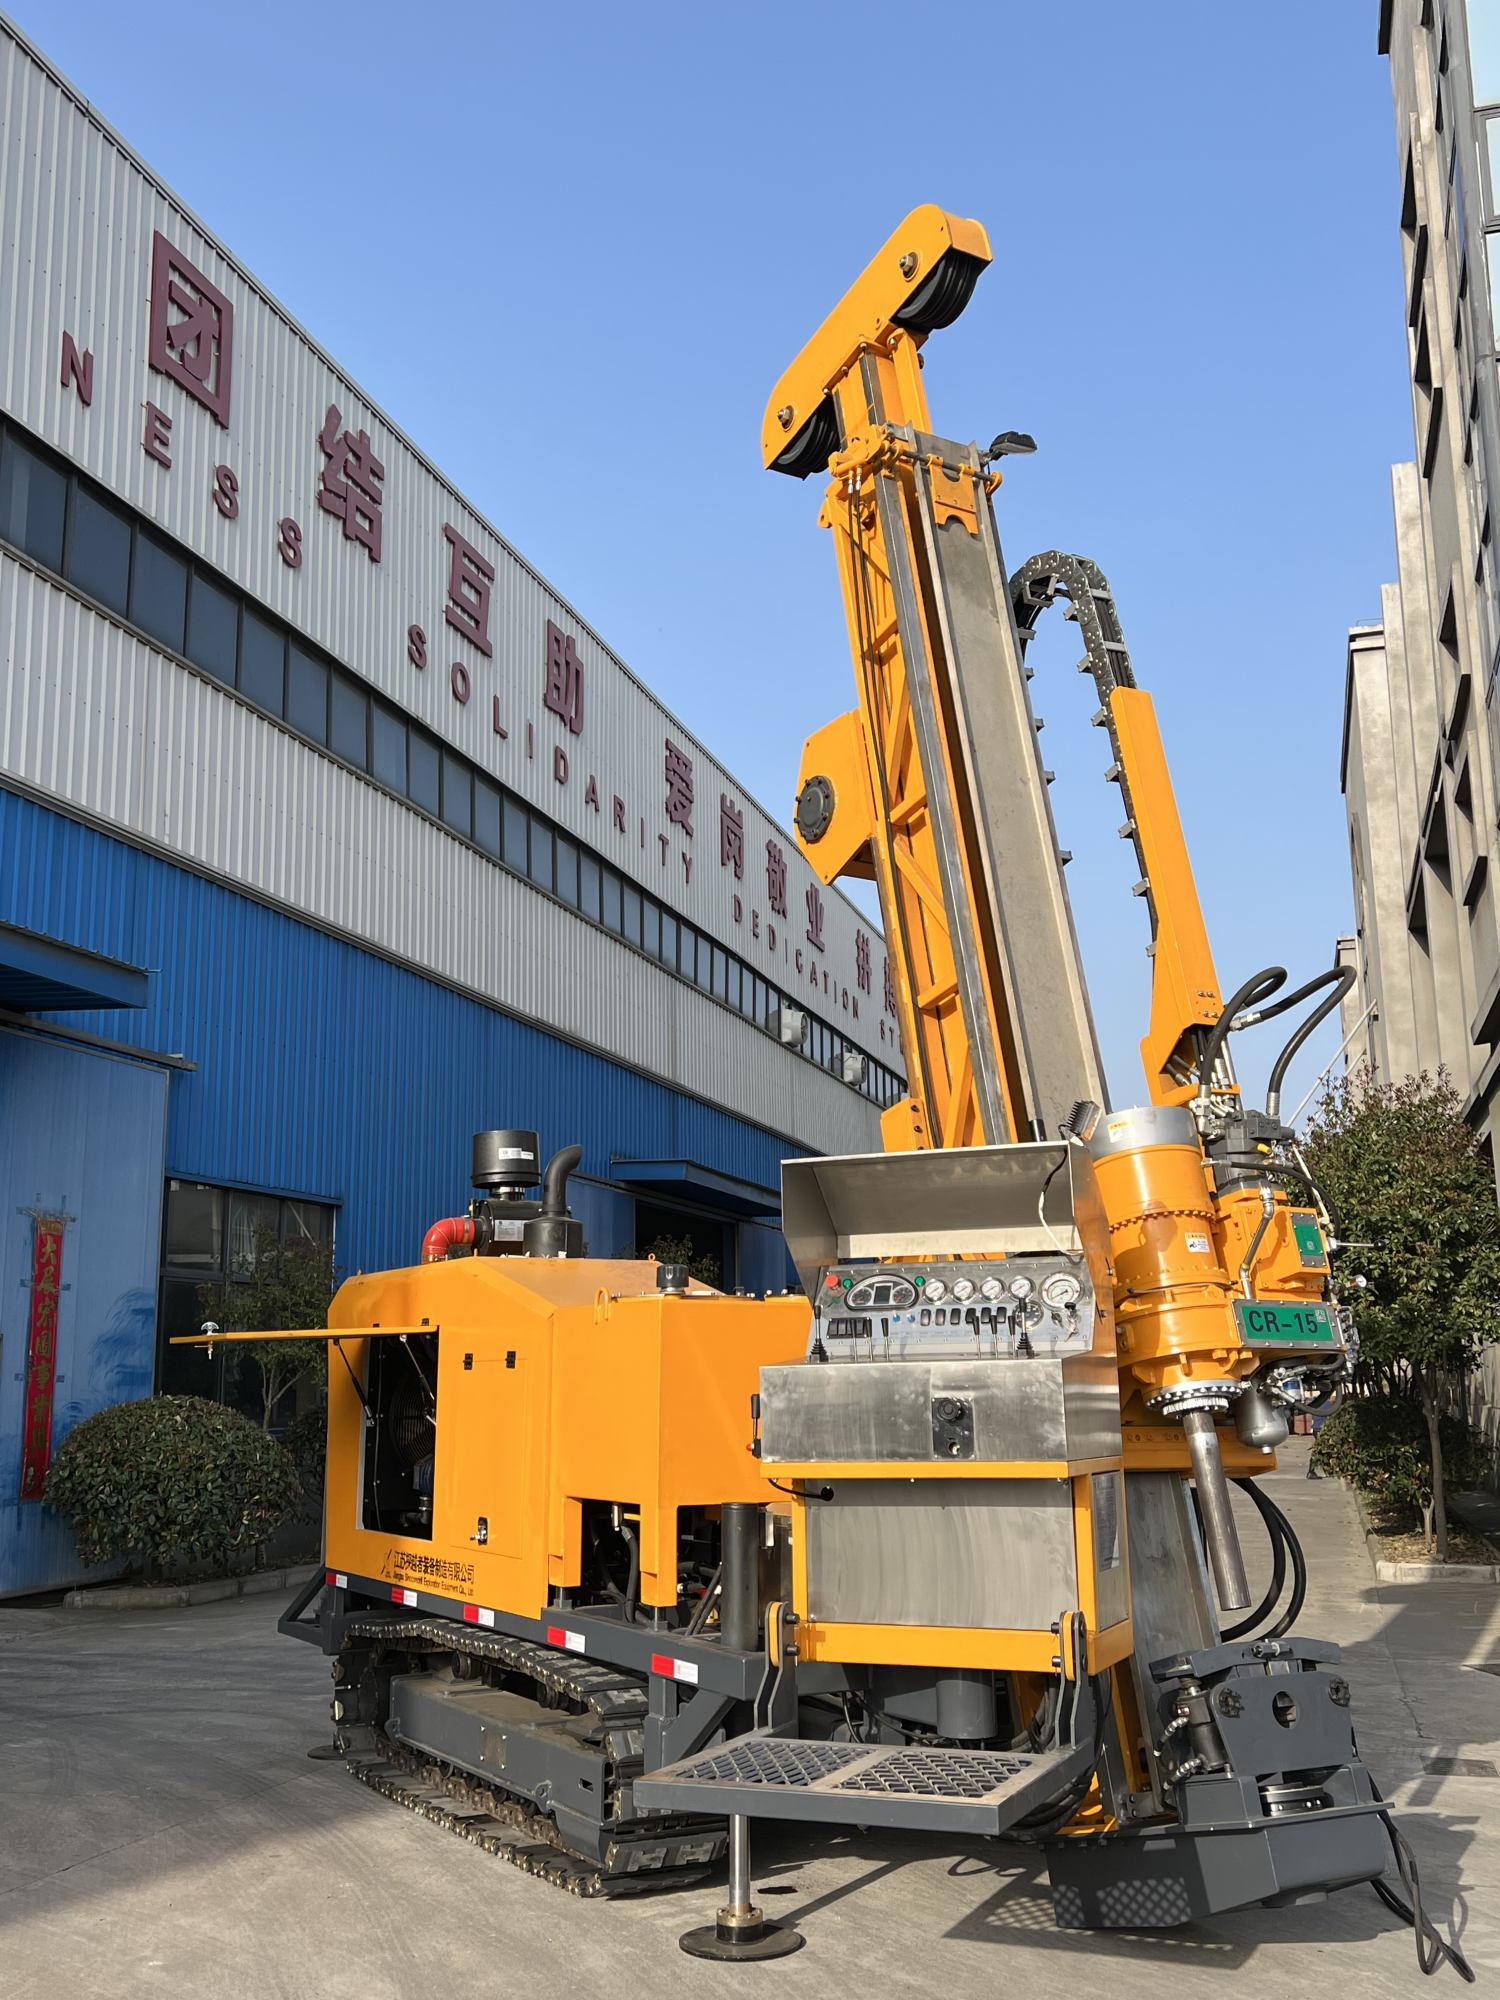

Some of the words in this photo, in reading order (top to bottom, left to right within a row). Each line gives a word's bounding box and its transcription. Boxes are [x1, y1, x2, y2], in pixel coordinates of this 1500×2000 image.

[60, 330, 303, 569] NESS
[407, 624, 694, 885] SOLIDARITY
[733, 893, 859, 1019] DEDICATION
[665, 737, 826, 953] 爱岗敬业
[1248, 1309, 1318, 1334] CR-15
